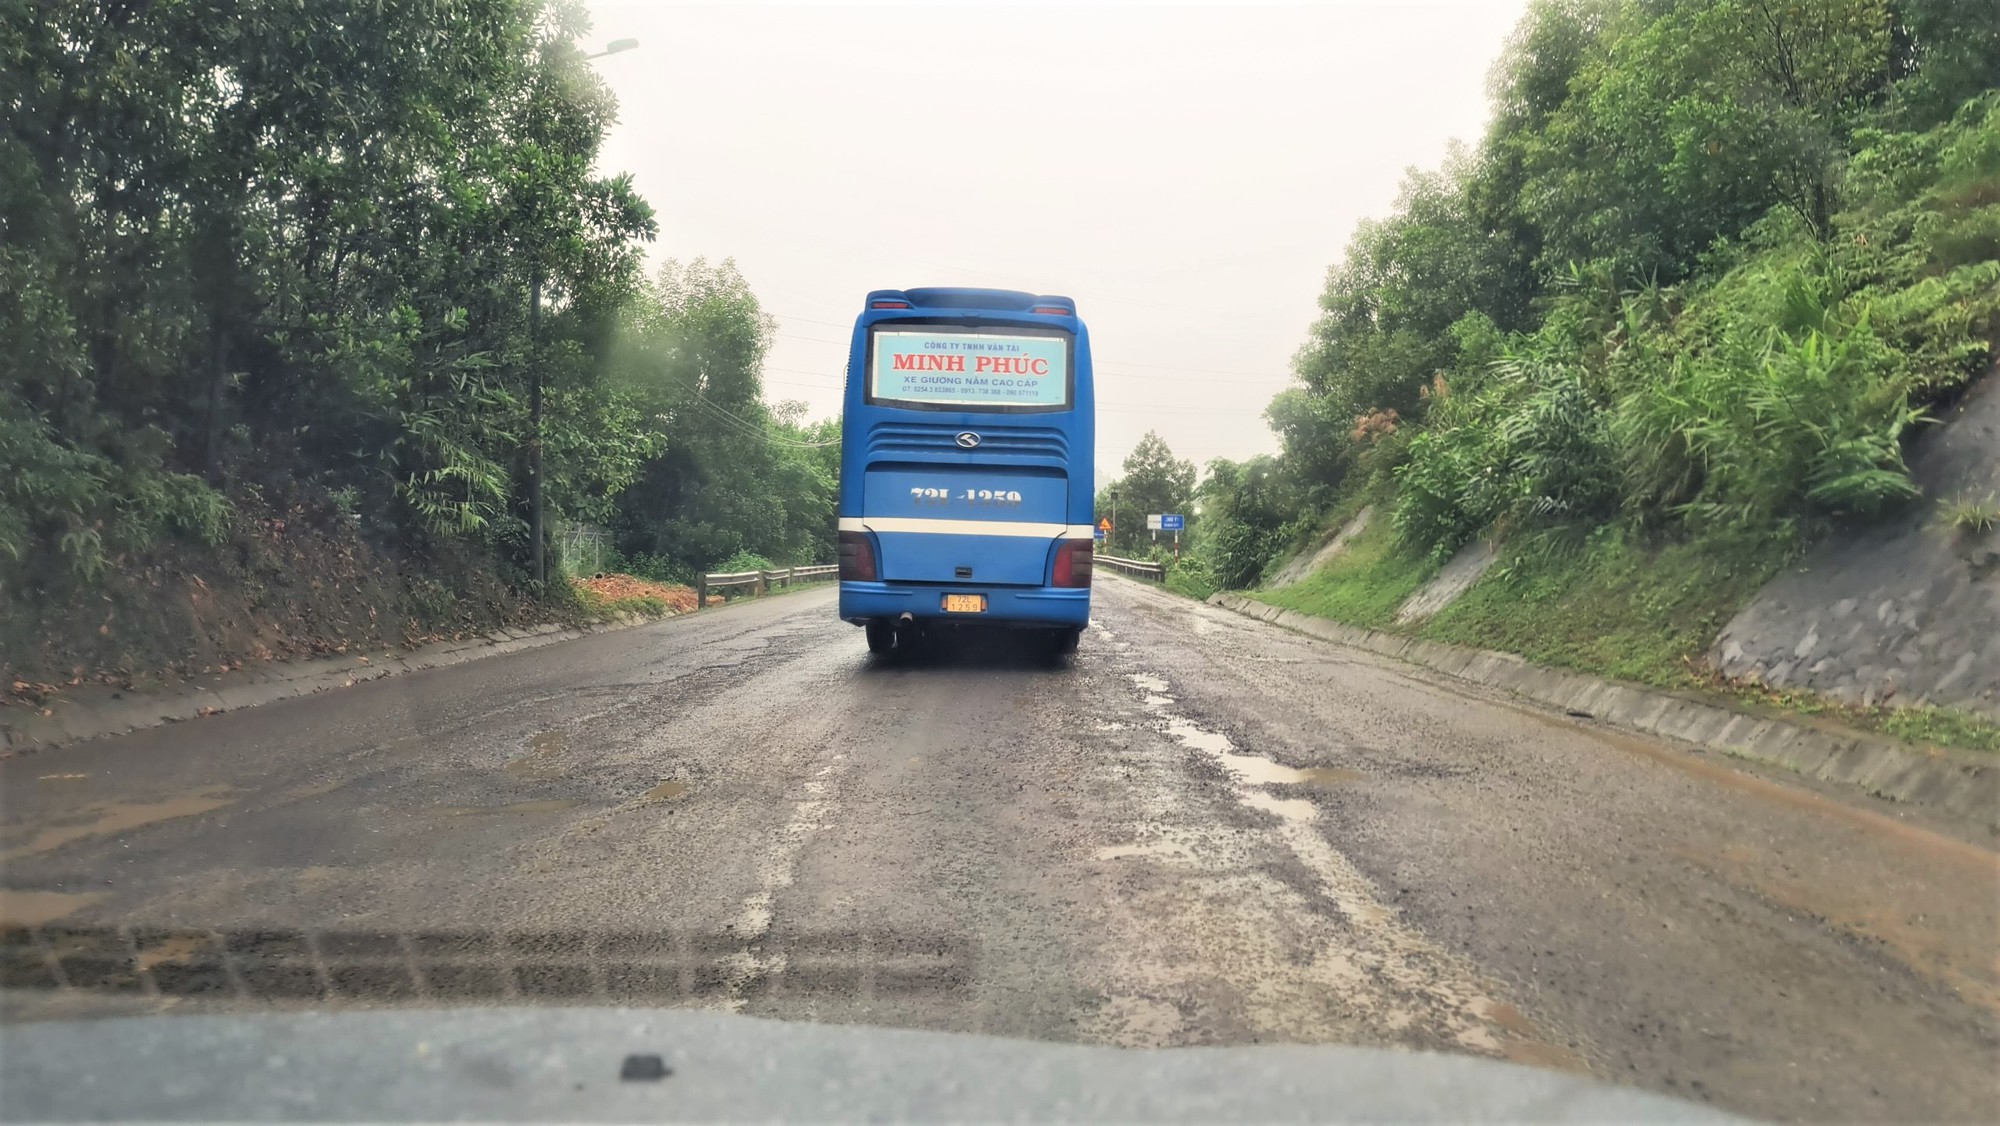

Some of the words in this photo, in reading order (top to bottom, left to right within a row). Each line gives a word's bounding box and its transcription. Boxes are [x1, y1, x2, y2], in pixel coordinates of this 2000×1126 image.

[924, 340, 947, 350] CÔNG
[949, 342, 960, 350] TY
[962, 342, 984, 351] TNHH
[893, 353, 965, 372] MINH
[975, 352, 1049, 375] PHÚC
[991, 378, 1014, 387] CAO
[956, 594, 972, 603] 72L
[951, 603, 978, 611] 1259
